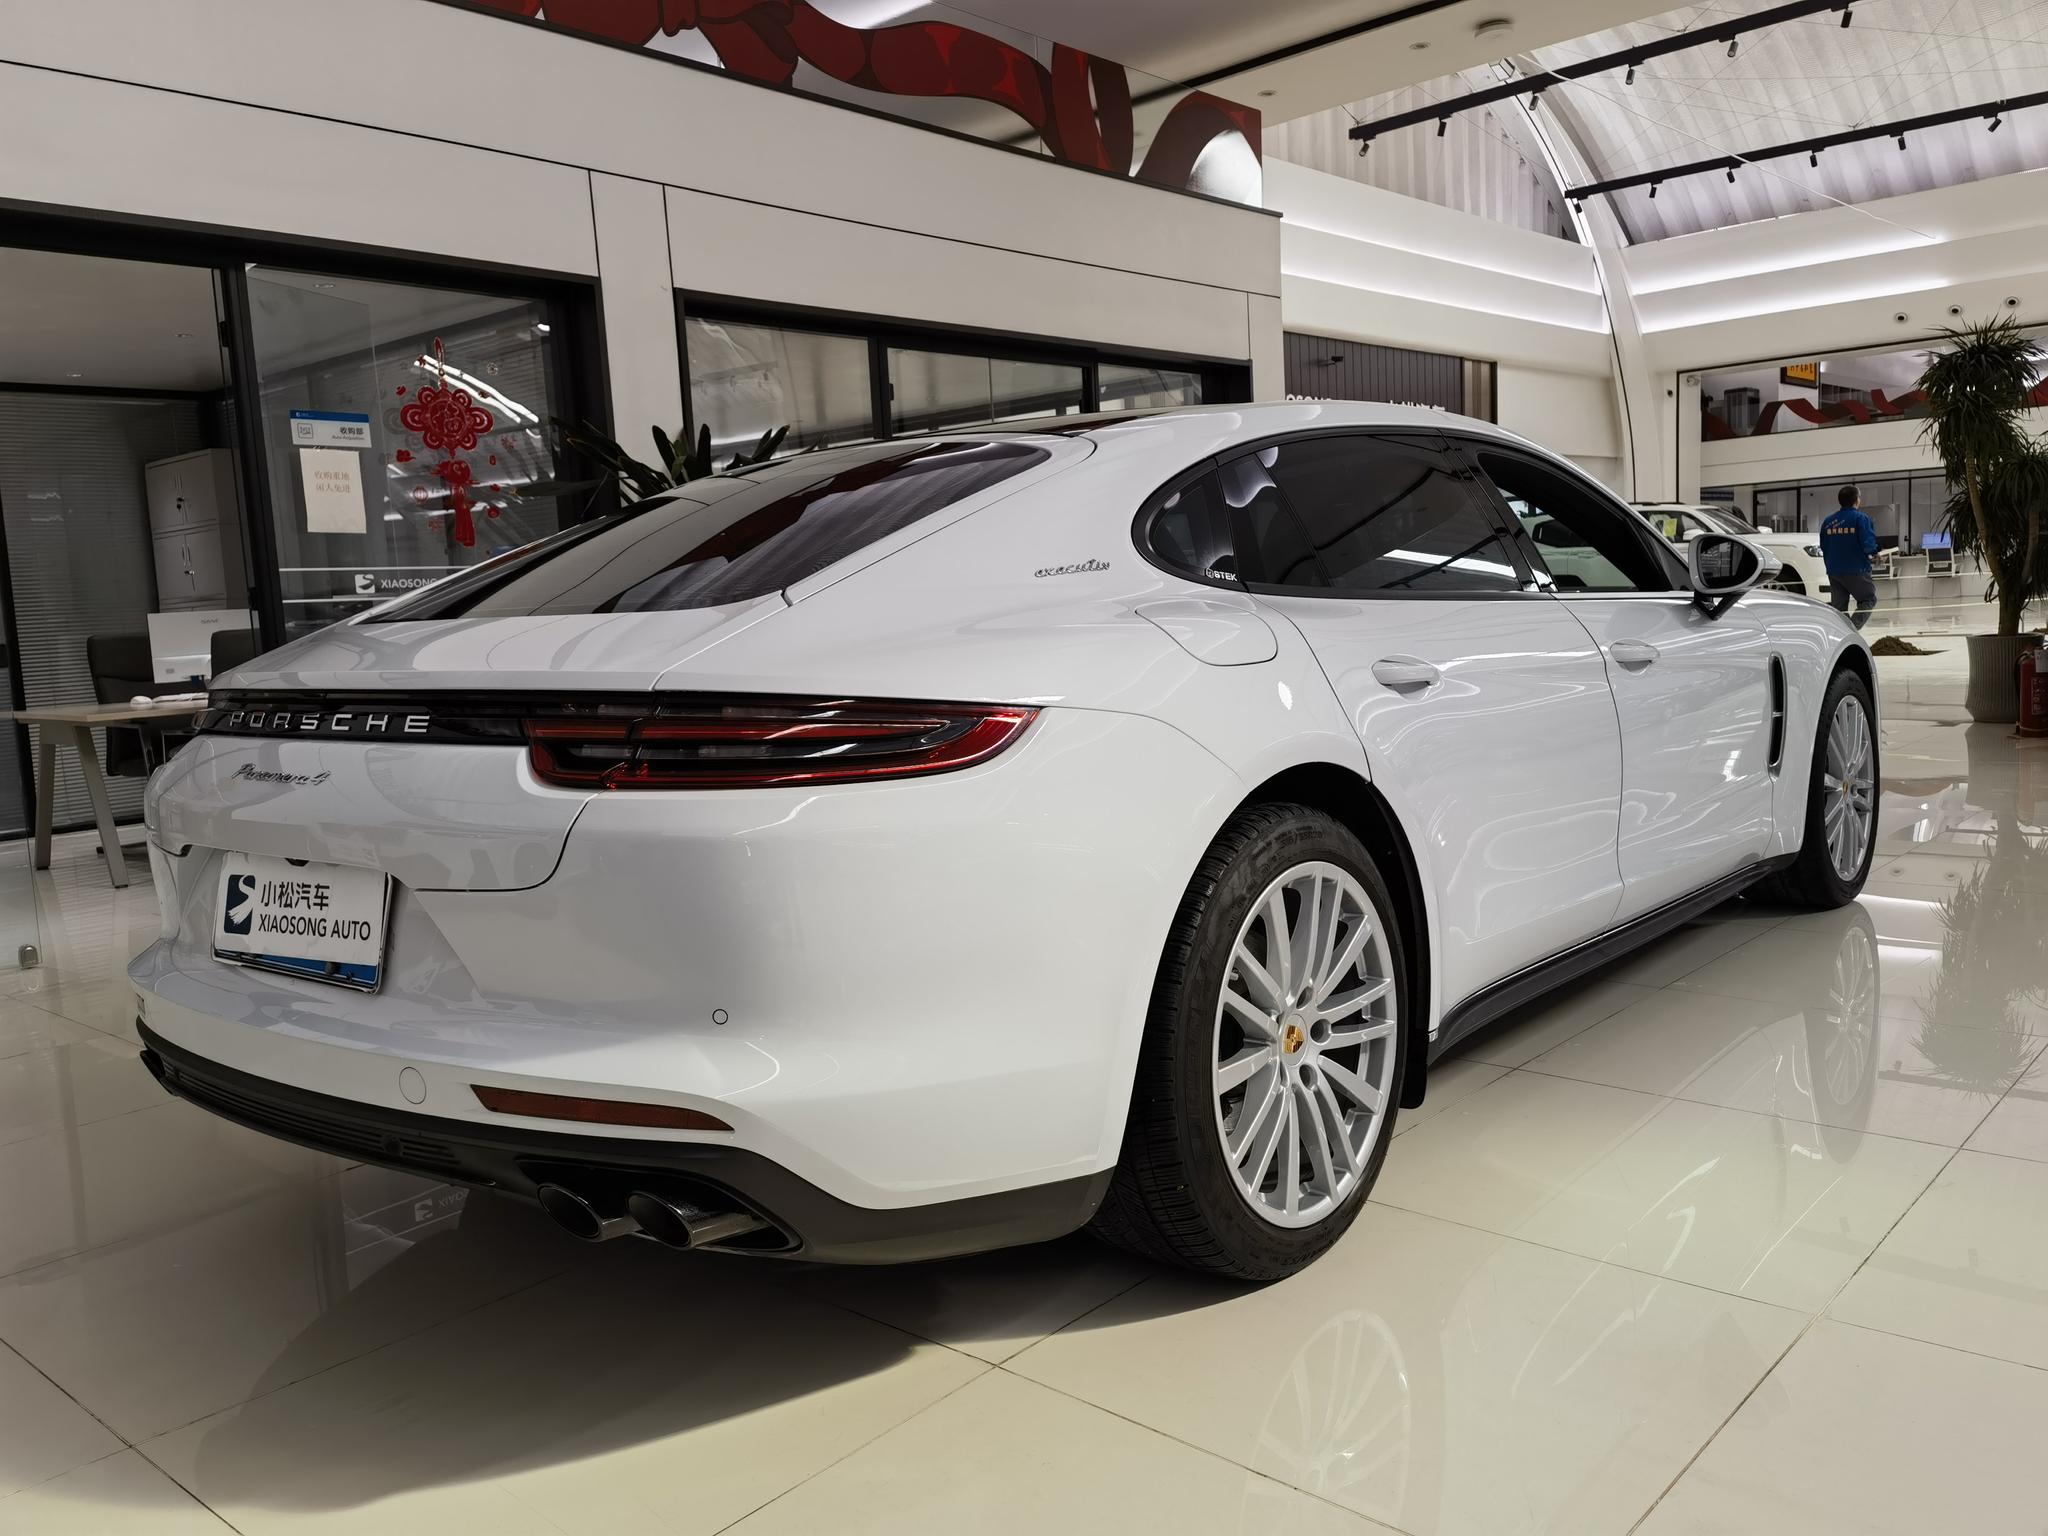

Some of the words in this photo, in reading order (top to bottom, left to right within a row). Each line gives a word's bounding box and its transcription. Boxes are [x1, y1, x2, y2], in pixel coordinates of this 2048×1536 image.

[230, 711, 430, 734] PORSCHE
[260, 880, 331, 911] 小松汽车
[258, 913, 328, 938] XIAOSONG
[330, 919, 372, 941] AUTO
